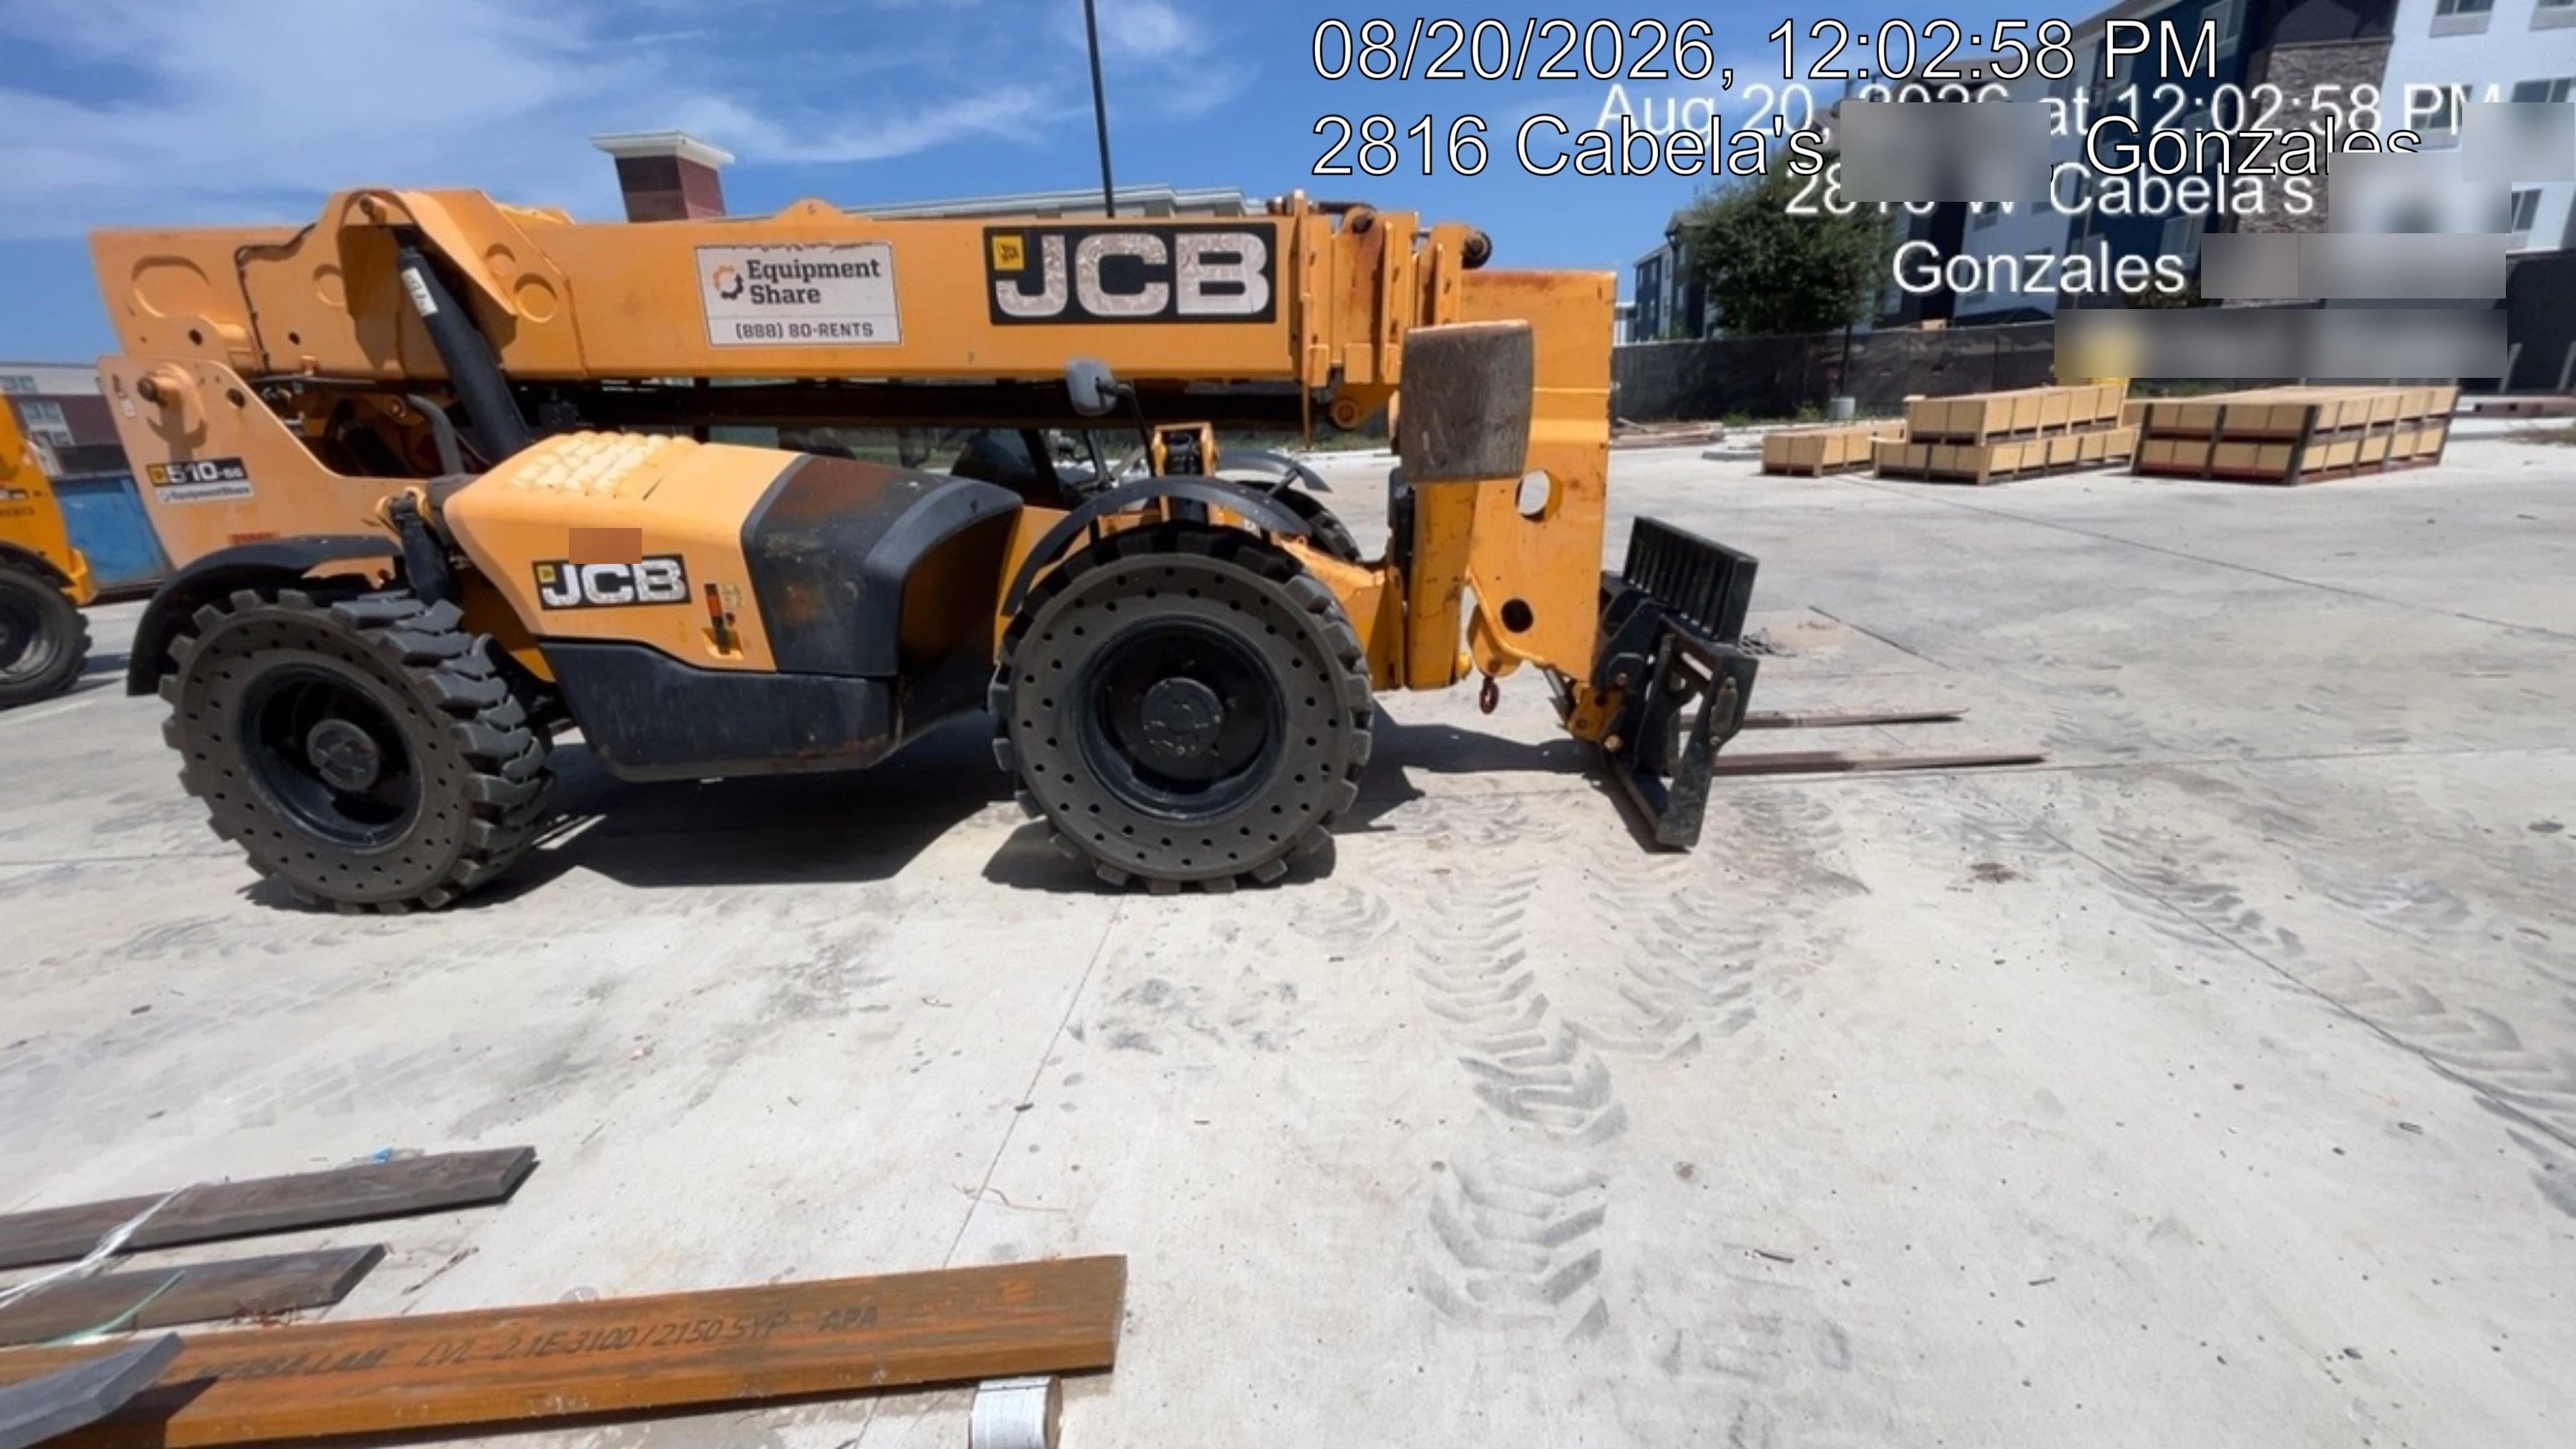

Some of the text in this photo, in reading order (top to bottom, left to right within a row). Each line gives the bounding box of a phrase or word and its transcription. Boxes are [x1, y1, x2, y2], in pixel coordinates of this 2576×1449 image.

[746, 258, 881, 283] Equipment
[995, 232, 1270, 317] JCB
[751, 285, 821, 305] Share
[736, 322, 874, 340] (888) 80-RENTS
[541, 558, 687, 607] JCB
[414, 1337, 477, 1368] LVL
